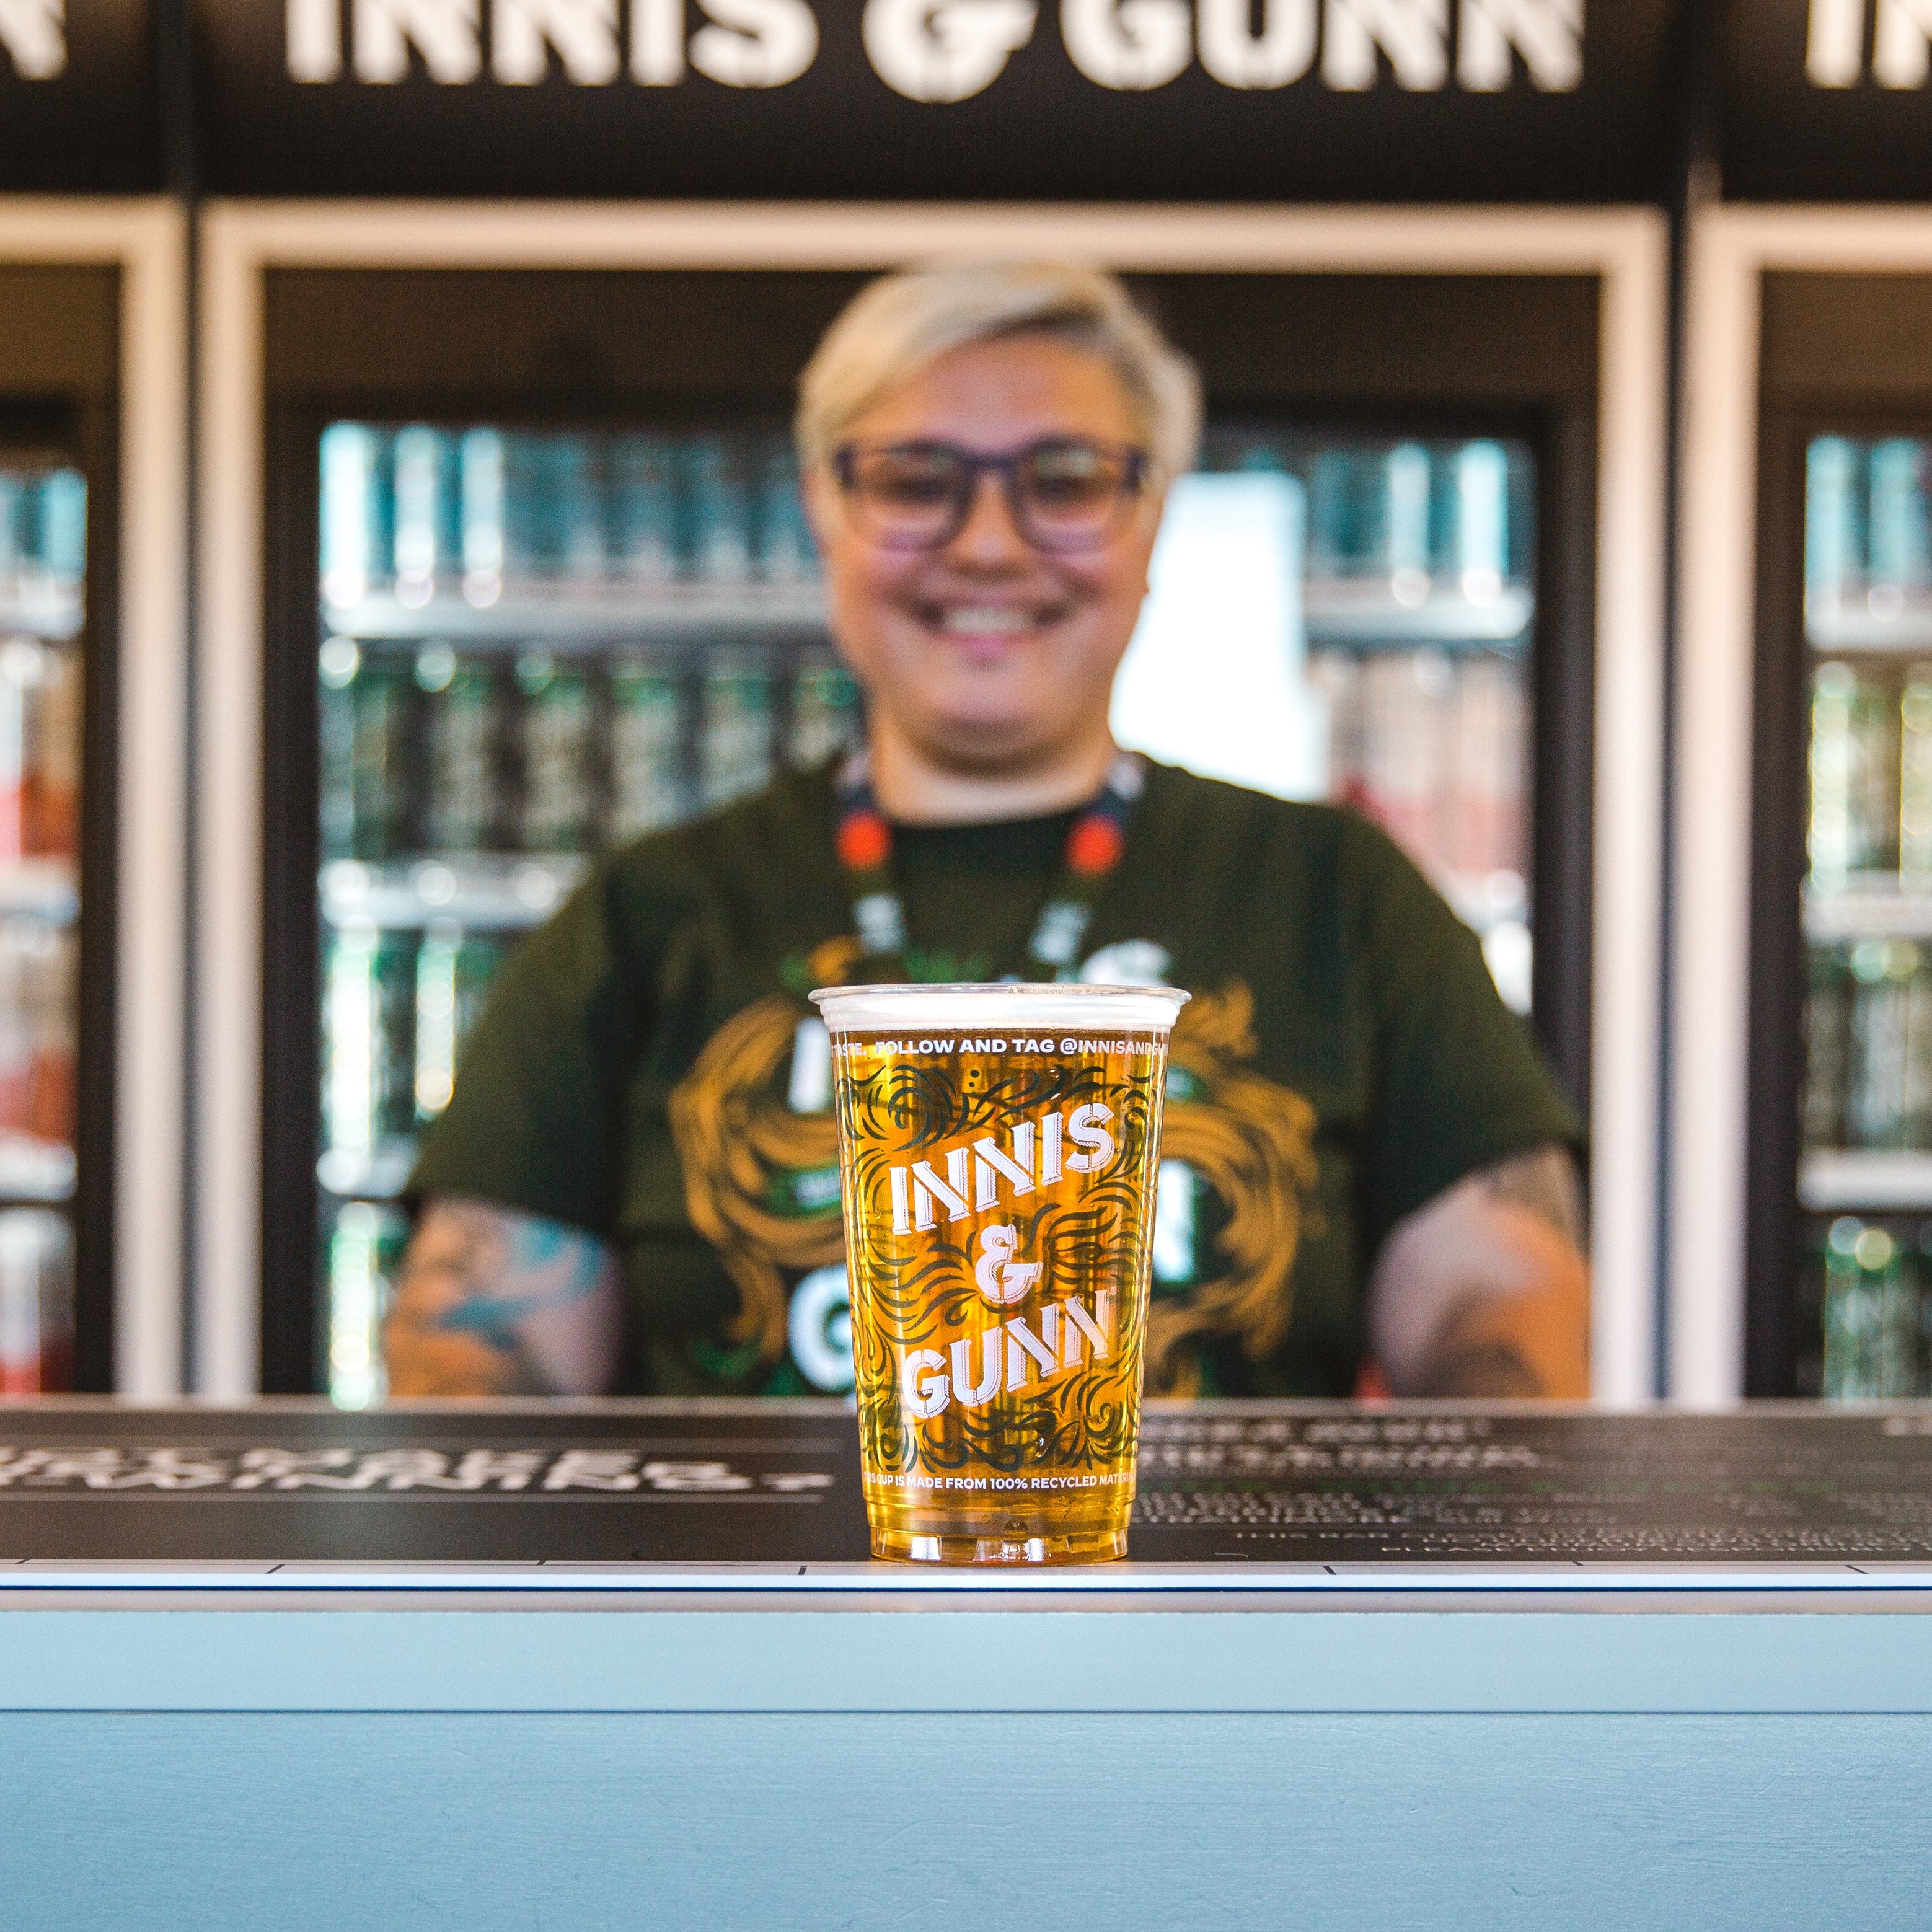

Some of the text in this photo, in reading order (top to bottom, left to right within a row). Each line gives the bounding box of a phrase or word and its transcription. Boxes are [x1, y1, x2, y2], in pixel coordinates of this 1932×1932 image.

[875, 1039, 955, 1054] FOLLOW
[959, 1039, 1007, 1053] AND
[1011, 1039, 1055, 1053] TAG
[889, 1103, 1115, 1236] INNIS
[975, 1224, 1044, 1305] &
[876, 1473, 894, 1486] CUP
[895, 1475, 905, 1487] IS
[907, 1476, 943, 1488] MADE
[945, 1478, 987, 1489] FROM
[990, 1478, 1028, 1489] 100%
[1031, 1476, 1097, 1489] RECYCLED
